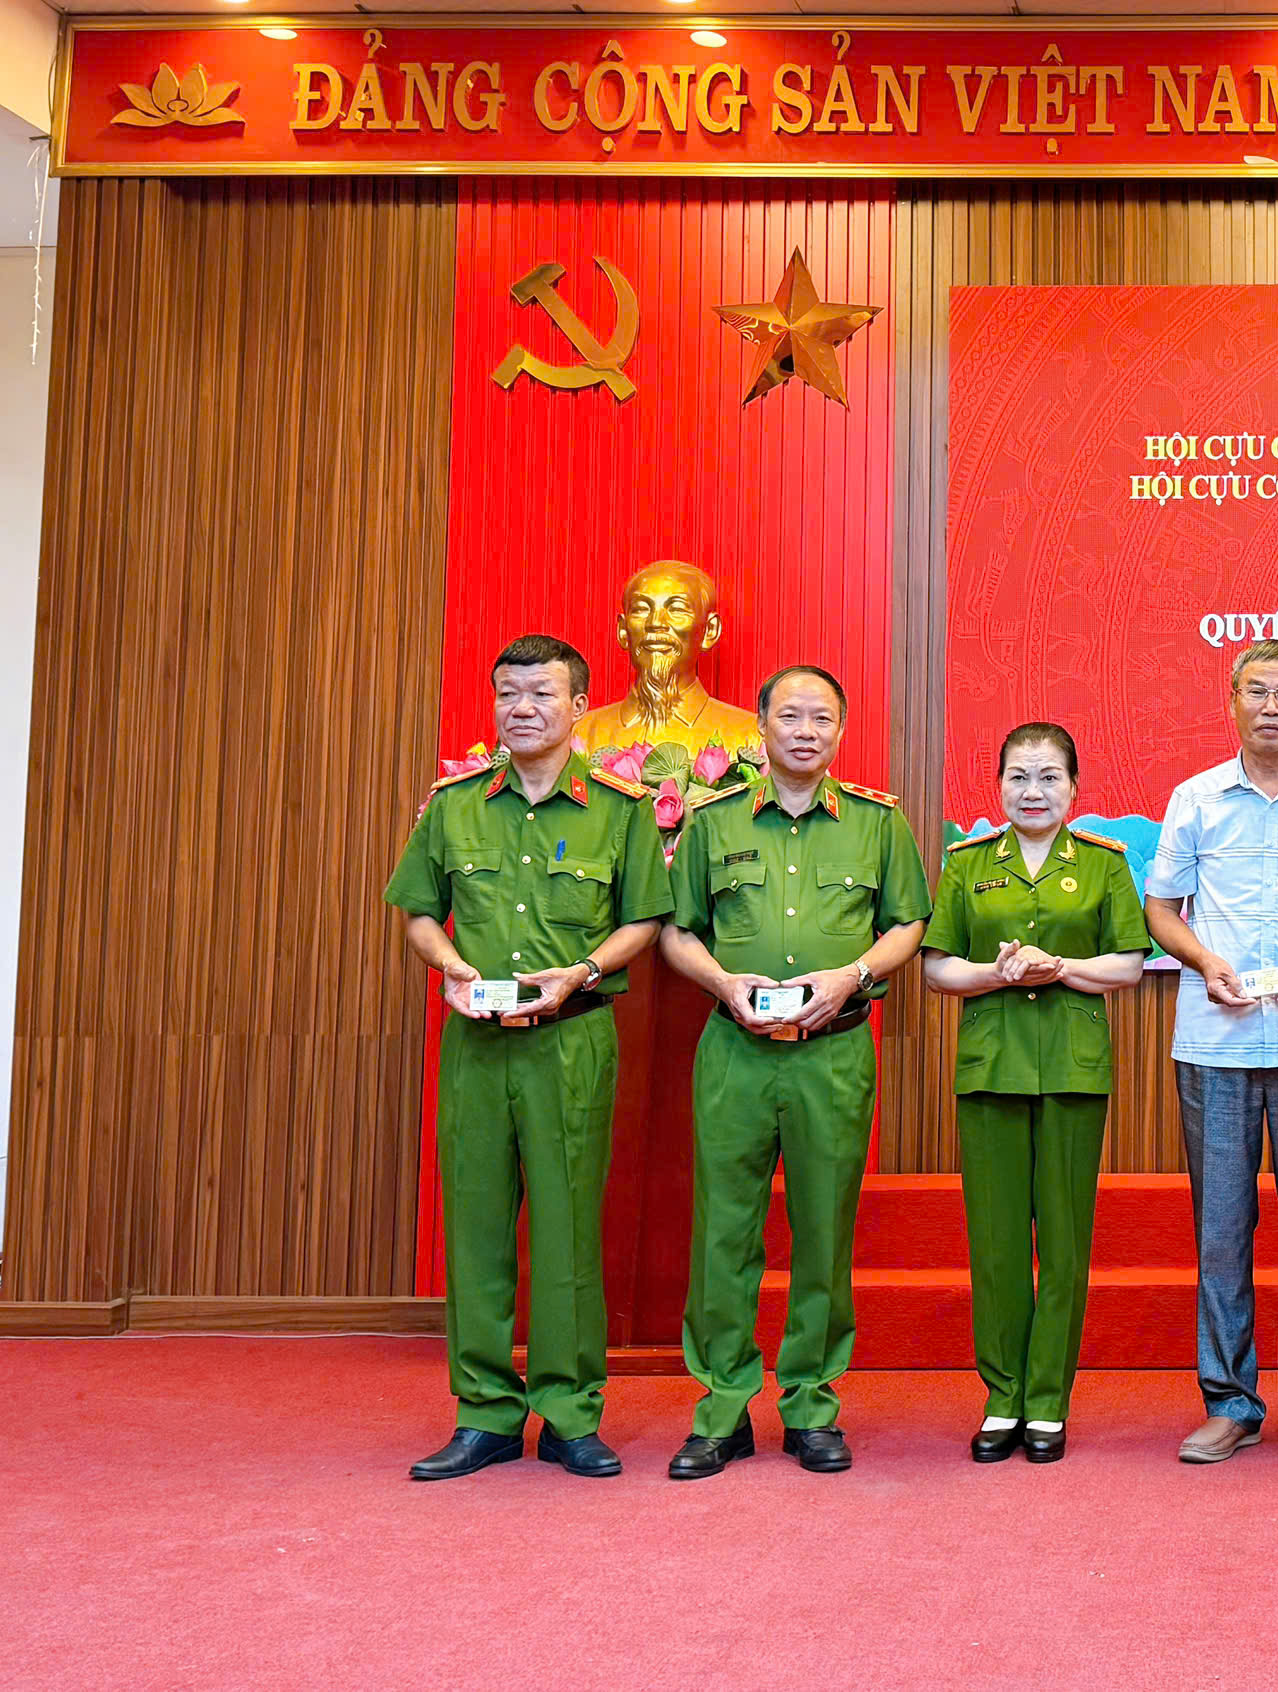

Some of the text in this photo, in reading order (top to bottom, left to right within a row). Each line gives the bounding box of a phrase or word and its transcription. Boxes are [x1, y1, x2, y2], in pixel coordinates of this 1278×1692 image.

[290, 28, 506, 132] ĐẢNG
[534, 40, 748, 153] CỘNG
[771, 30, 922, 134] SẢN
[946, 43, 1123, 155] VIỆT
[1144, 431, 1198, 466] HỘI
[1203, 431, 1266, 466] CỰU
[1129, 471, 1184, 506] HỘI
[1188, 471, 1251, 506] CỰU
